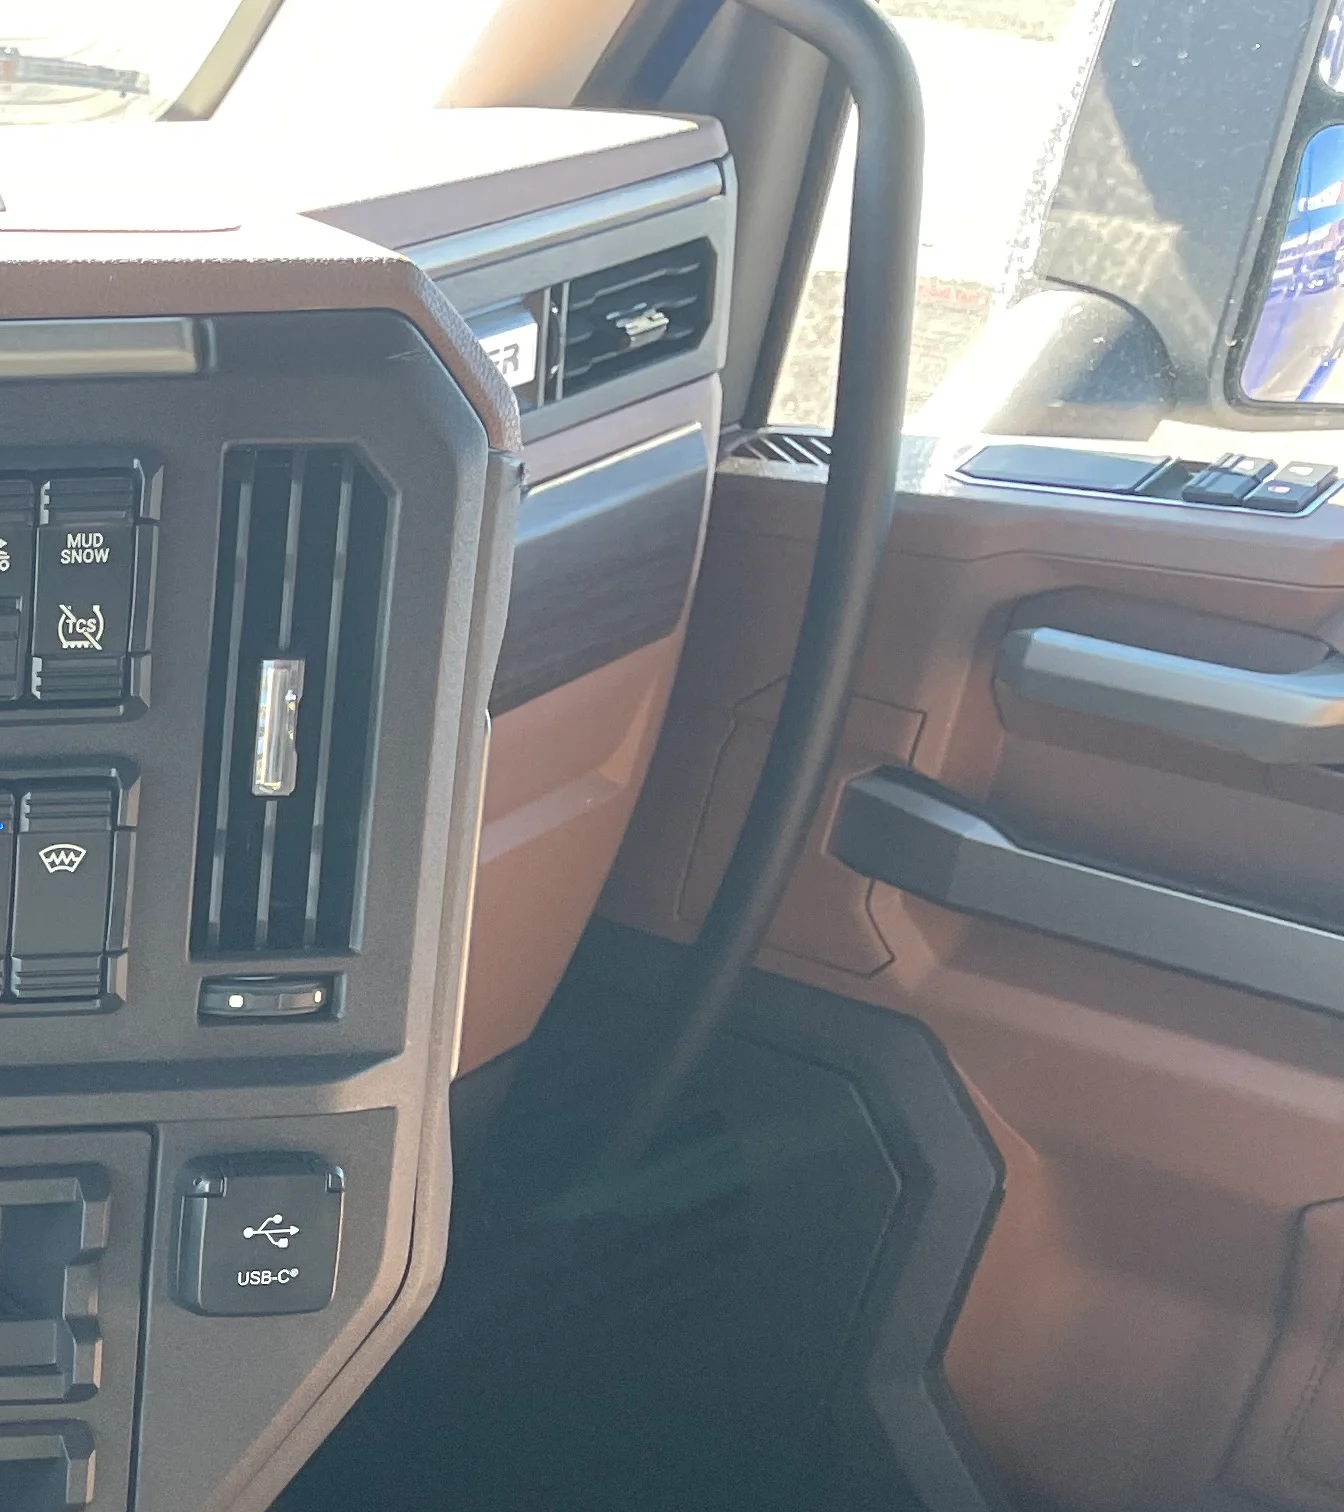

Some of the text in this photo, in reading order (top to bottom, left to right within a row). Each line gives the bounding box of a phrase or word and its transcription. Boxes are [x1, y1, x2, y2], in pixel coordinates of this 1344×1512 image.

[66, 532, 104, 549] MUD
[60, 547, 110, 565] SNOW
[65, 618, 97, 634] TCS
